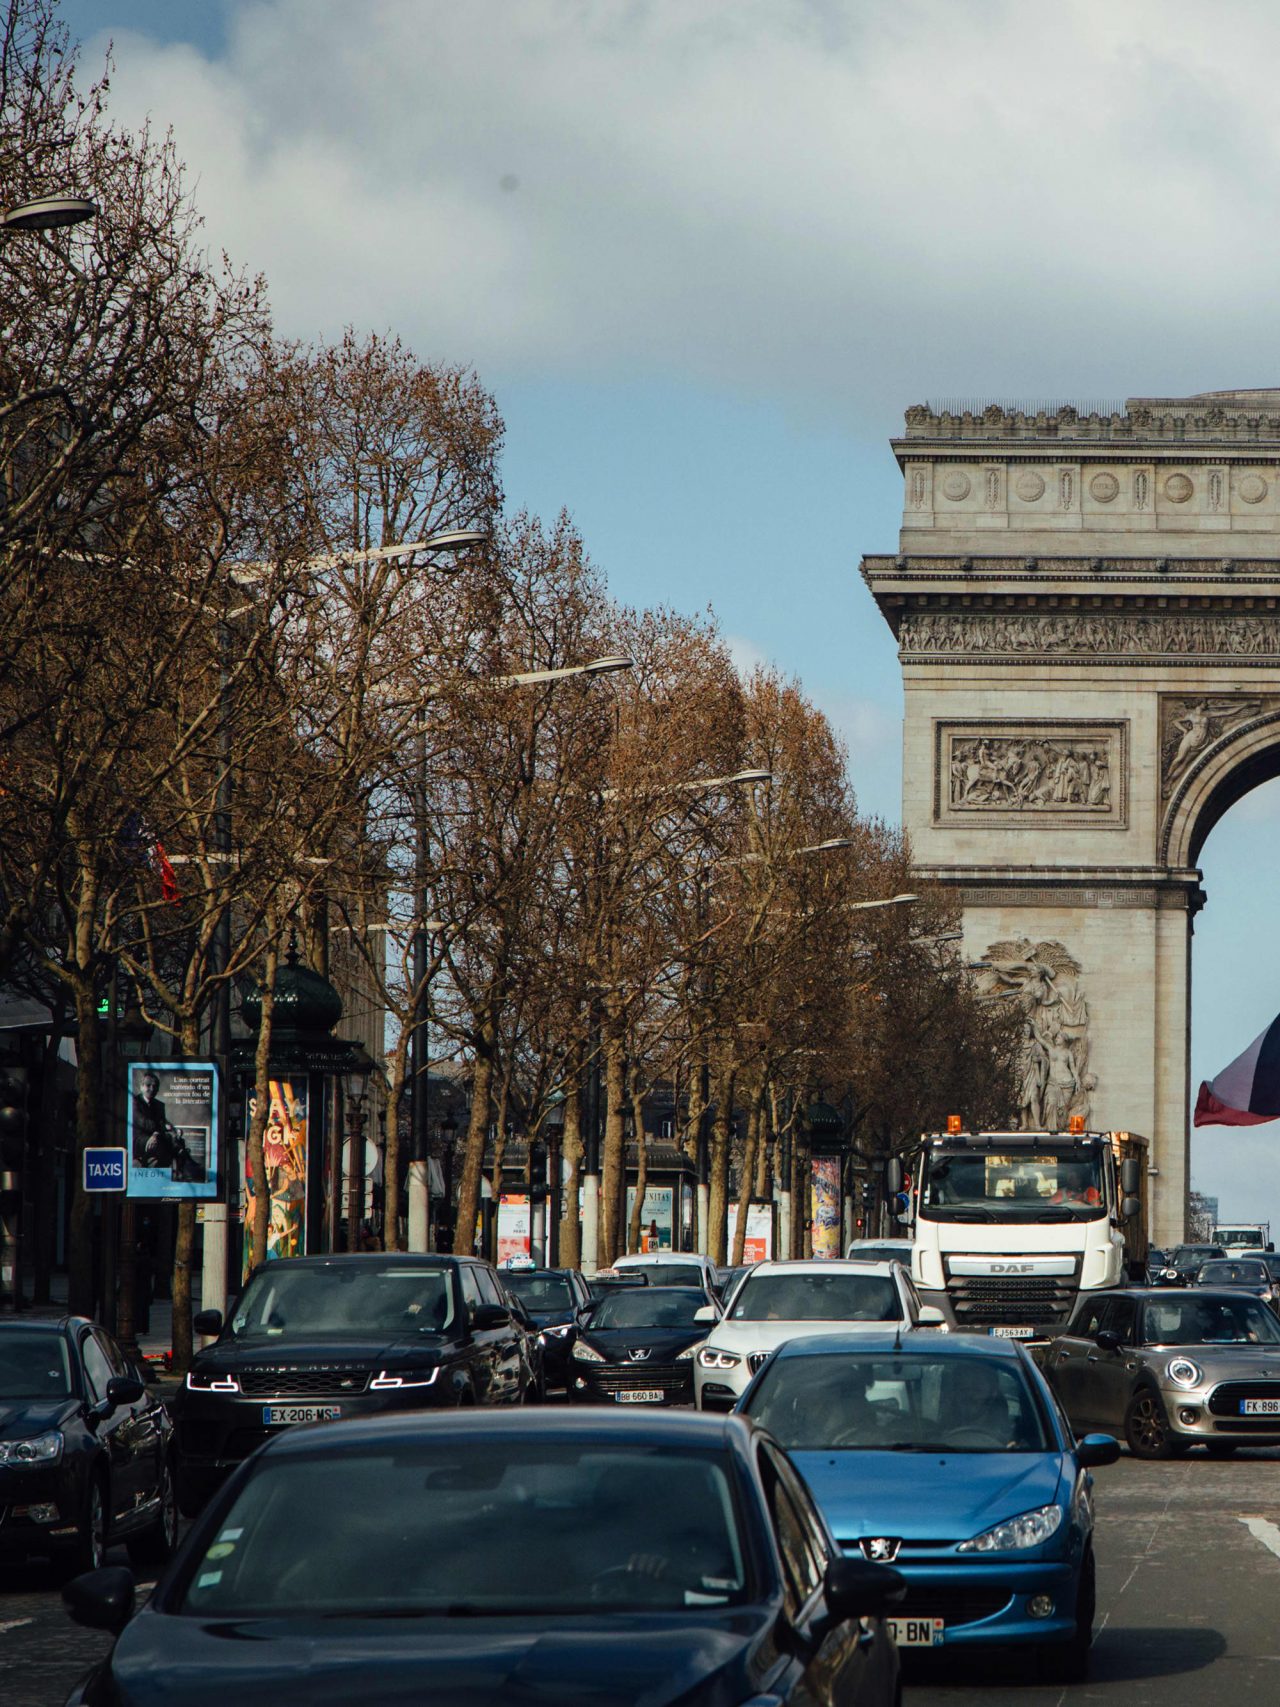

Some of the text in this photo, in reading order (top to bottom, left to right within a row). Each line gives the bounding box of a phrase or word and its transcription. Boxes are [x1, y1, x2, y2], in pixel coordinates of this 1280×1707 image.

[249, 1098, 299, 1123] SAY
[88, 1163, 122, 1177] TAXIS
[990, 1265, 1034, 1273] DAF
